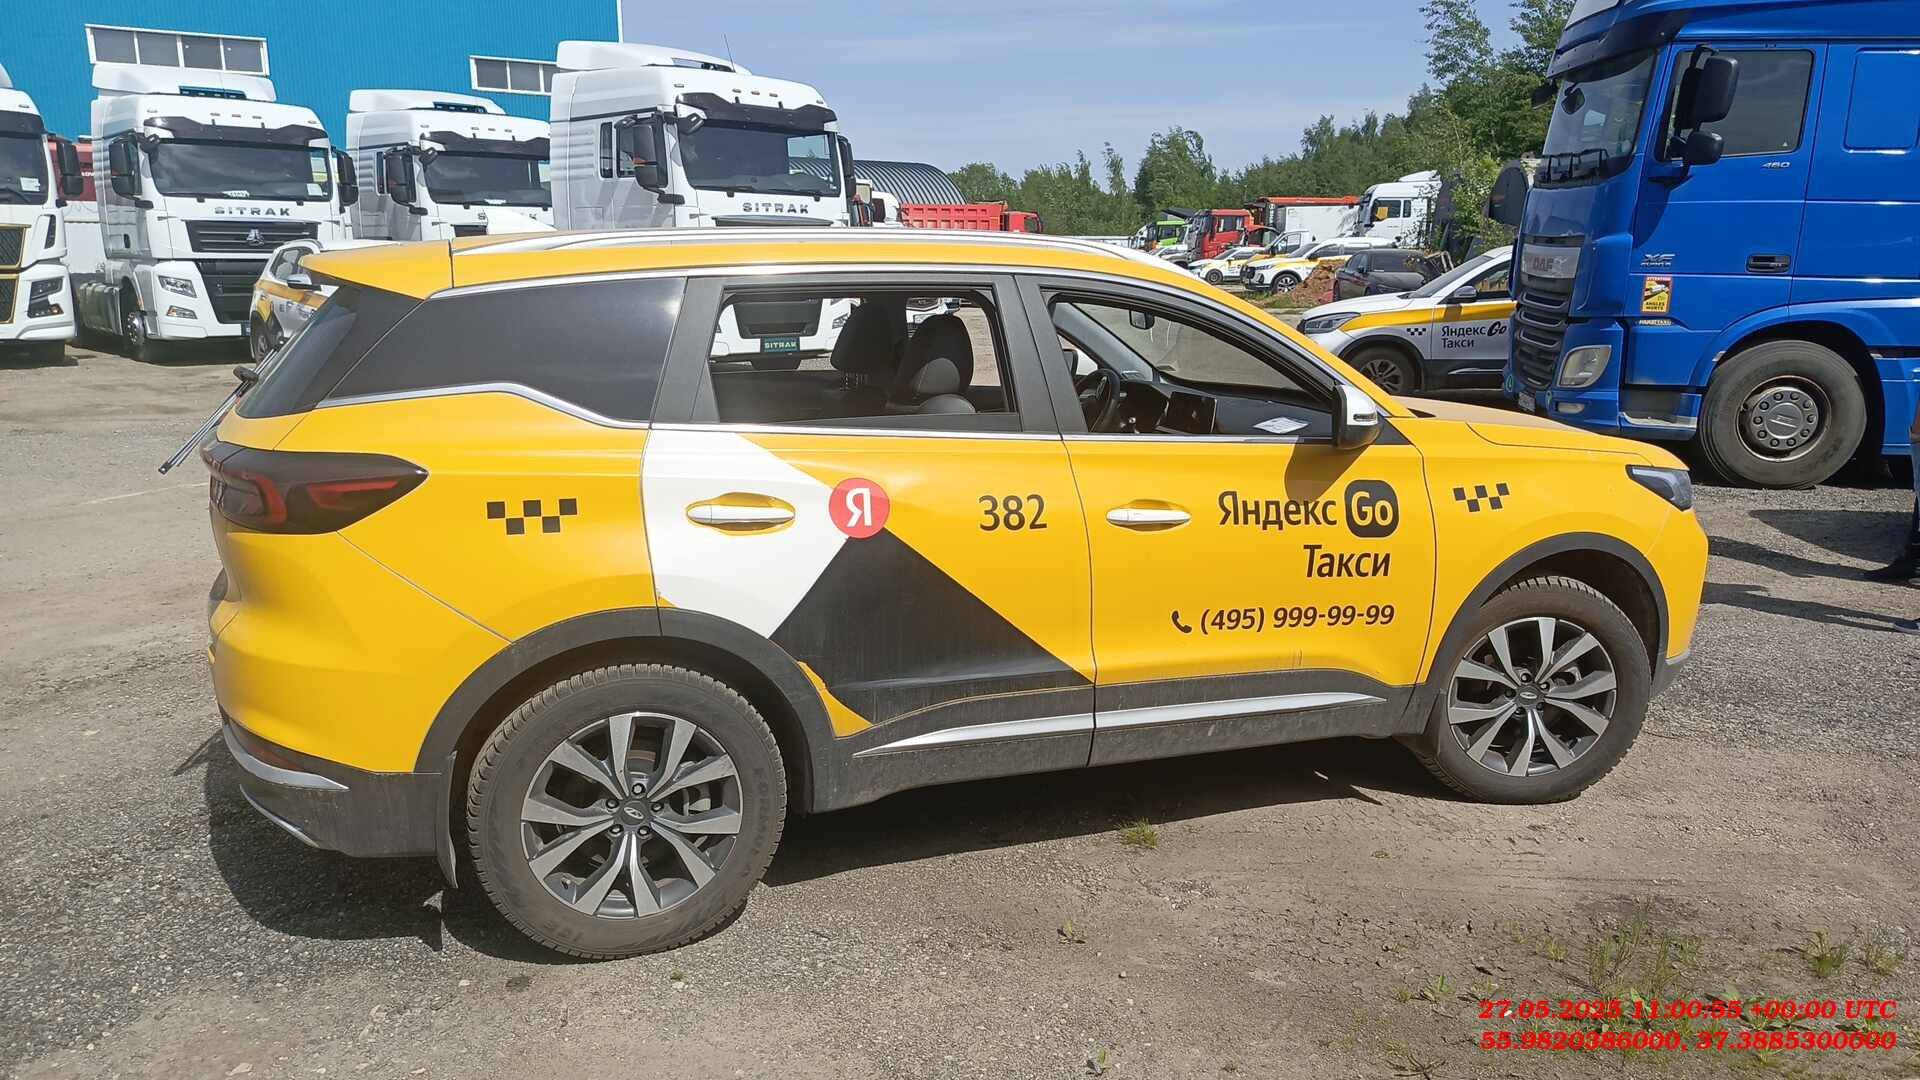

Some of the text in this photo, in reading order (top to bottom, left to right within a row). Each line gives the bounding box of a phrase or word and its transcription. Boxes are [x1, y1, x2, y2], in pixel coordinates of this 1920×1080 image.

[214, 206, 290, 216] SITRAK
[742, 202, 809, 214] SITRAK
[1441, 321, 1507, 337] Яндекс Go
[764, 341, 797, 349] SITRAK
[1441, 338, 1474, 349] Такси
[845, 487, 872, 527] Я
[978, 494, 1047, 531] 382
[1218, 490, 1394, 530] Яндекс Go
[1303, 544, 1391, 578] Такси
[1200, 604, 1395, 635] (495) 999-99-99
